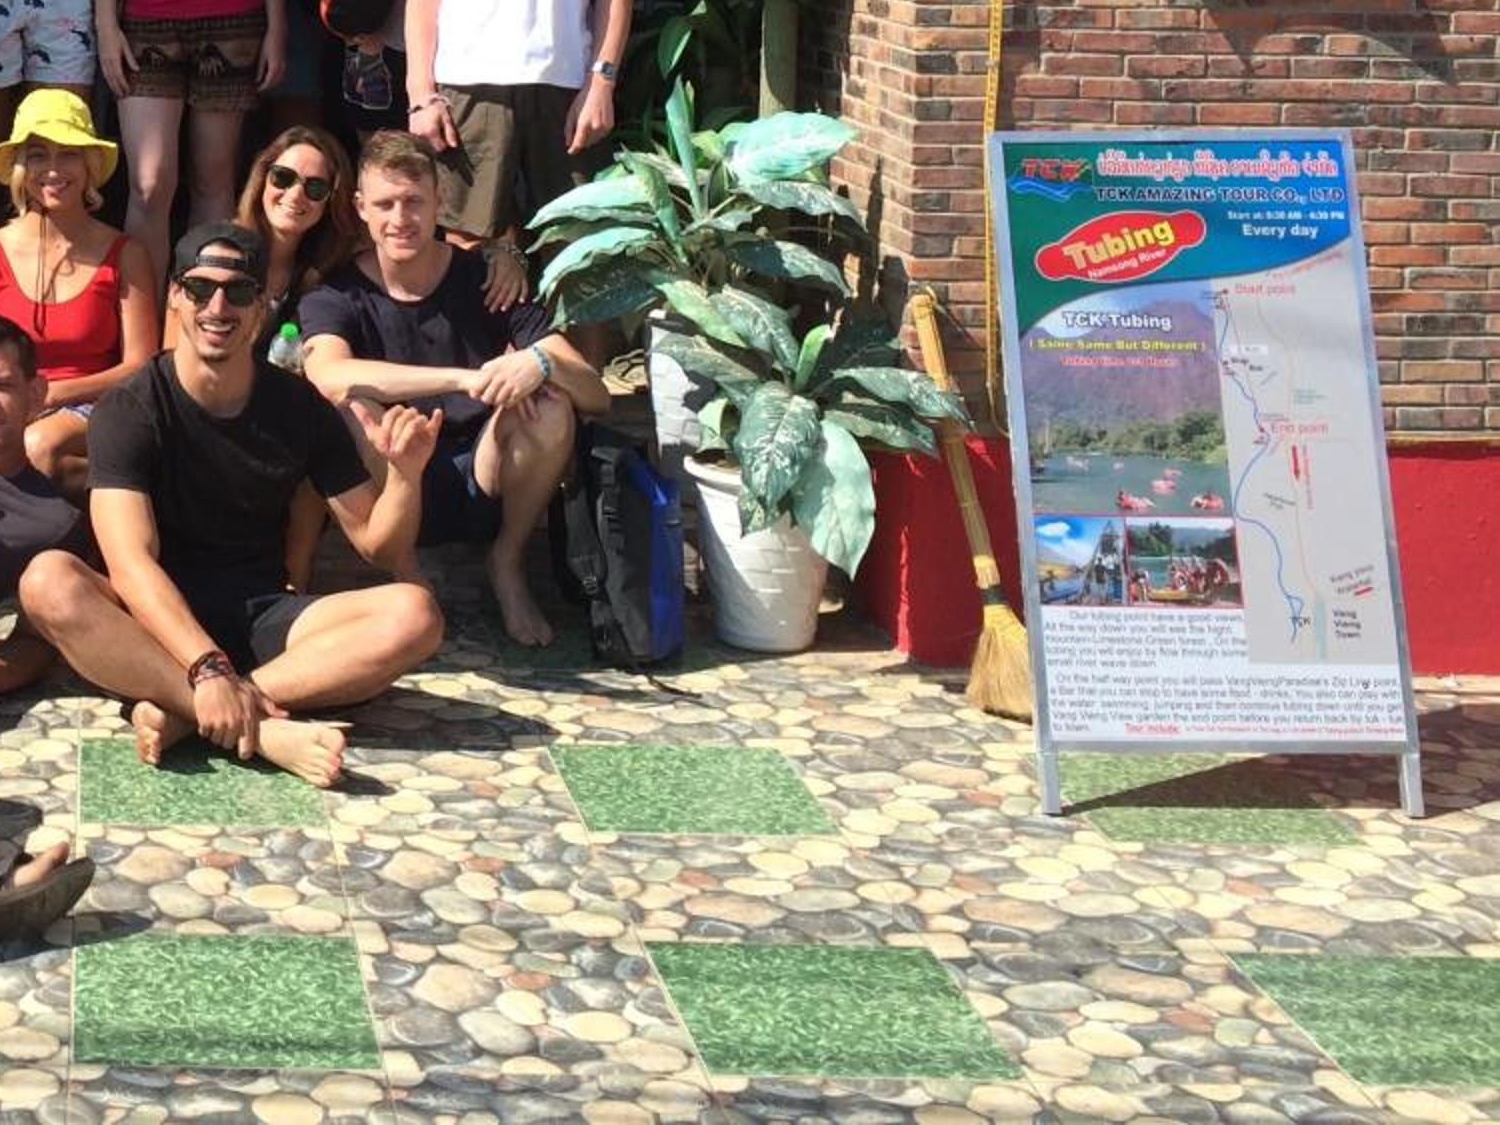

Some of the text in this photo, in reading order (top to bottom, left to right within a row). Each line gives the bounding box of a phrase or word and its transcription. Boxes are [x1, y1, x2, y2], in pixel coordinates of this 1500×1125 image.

[1095, 187, 1132, 203] TCK
[1134, 187, 1217, 203] AMAZING
[1219, 187, 1269, 203] TOUR
[1309, 187, 1345, 203] LTD
[1243, 224, 1319, 239] Every day
[1062, 220, 1176, 270] Tubing
[1139, 248, 1167, 264] River
[1109, 313, 1173, 332] Tubing
